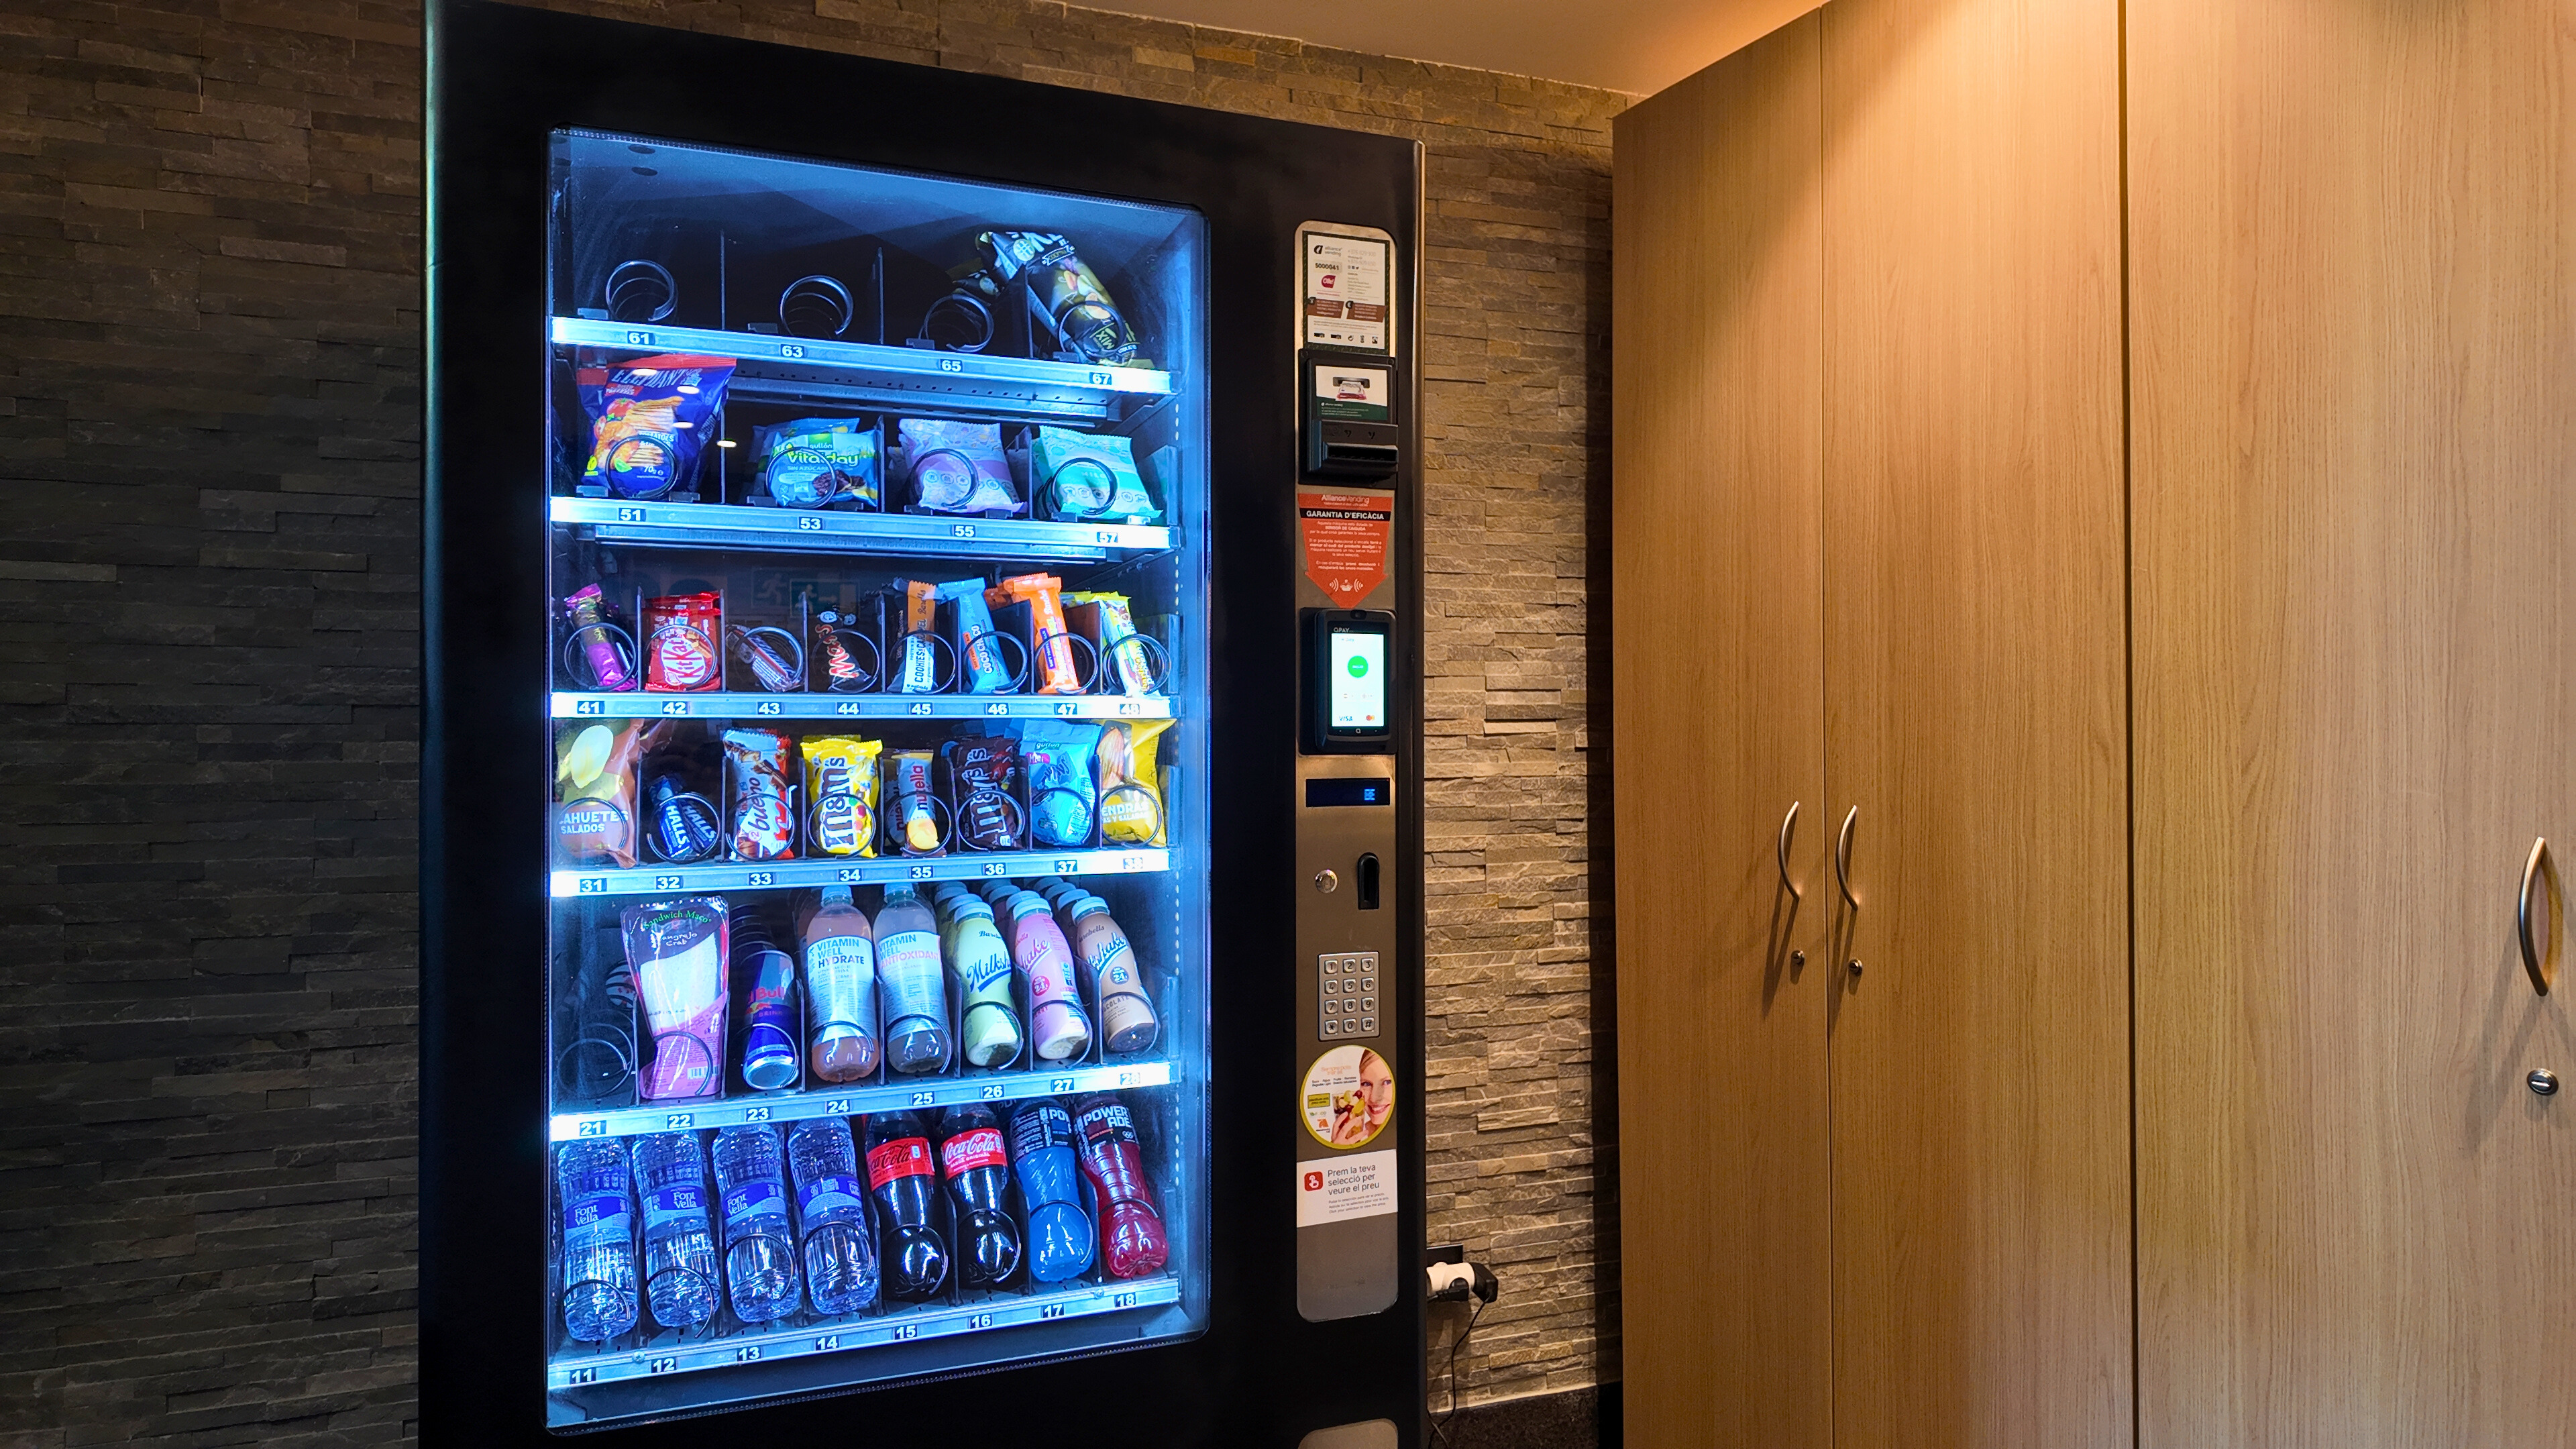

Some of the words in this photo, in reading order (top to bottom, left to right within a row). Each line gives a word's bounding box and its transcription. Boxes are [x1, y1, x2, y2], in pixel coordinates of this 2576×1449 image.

[629, 332, 649, 344] 61
[782, 345, 803, 358] 63
[941, 360, 962, 372] 65
[1092, 373, 1110, 384] 67
[620, 509, 641, 521] 51
[1344, 511, 1385, 520] D'EFICÀCIA
[800, 517, 821, 529] 53
[955, 526, 975, 537] 55
[1099, 532, 1118, 543] 57
[971, 624, 987, 652] CHCO
[816, 624, 860, 679] Mars
[662, 639, 703, 679] KitKat
[979, 651, 994, 674] COCO
[914, 653, 926, 683] COOKIES
[579, 702, 600, 714] 41
[663, 702, 686, 714] 42
[759, 702, 780, 714] 43
[838, 703, 859, 714] 44
[911, 703, 932, 715] 45
[987, 703, 1008, 715] 46
[1057, 704, 1076, 715] 47
[1121, 704, 1140, 715] 48
[912, 765, 928, 811] nuella
[739, 789, 749, 816] kinr
[747, 776, 771, 831] bueno
[1102, 801, 1149, 816] ENDRAS
[561, 823, 605, 835] SALADOS
[912, 867, 932, 878] 35
[985, 864, 1005, 875] 36
[1058, 861, 1076, 872] 37
[750, 873, 771, 885] 33
[840, 869, 861, 881] 34
[581, 879, 602, 892] 31
[657, 876, 680, 889] 32
[643, 910, 683, 930] Sandwich
[661, 931, 698, 941] angrejo
[665, 938, 688, 947] Crab
[817, 938, 859, 951] VITAMIN
[878, 934, 916, 952] VITAMIN
[818, 947, 843, 959] WELL
[879, 946, 901, 960] WELL
[881, 950, 939, 969] ANTIOXIDANT
[1021, 938, 1051, 970] hake
[818, 955, 865, 969] HYDRATE
[966, 951, 1012, 992] Milksh
[1053, 1079, 1073, 1091] 27
[1122, 1073, 1140, 1085] 28
[983, 1085, 1003, 1098] 26
[913, 1093, 934, 1106] 25
[828, 1100, 849, 1113] 24
[668, 1114, 690, 1128] 22
[747, 1108, 769, 1122] 23
[1083, 1106, 1128, 1126] POWER
[580, 1122, 602, 1135] 21
[1108, 1116, 1132, 1128] ADE
[945, 1132, 996, 1165] Coca-Cola
[1328, 1169, 1348, 1177] Prem
[1359, 1165, 1376, 1173] teva
[1328, 1175, 1360, 1186] selecció
[1362, 1174, 1376, 1183] per
[1328, 1186, 1351, 1195] veure
[1352, 1184, 1360, 1192] el
[1362, 1181, 1380, 1192] preu
[673, 1191, 696, 1201] Font
[727, 1193, 747, 1209] Font
[673, 1197, 697, 1209] Vella
[728, 1201, 749, 1216] Vella
[575, 1204, 598, 1218] Font
[575, 1213, 600, 1226] Vella
[1118, 1293, 1135, 1306] 18
[1044, 1304, 1063, 1317] 17
[972, 1314, 991, 1328] 16
[896, 1326, 916, 1339] 15
[817, 1336, 839, 1350] 14
[739, 1346, 760, 1360] 13
[653, 1359, 676, 1373] 12
[572, 1370, 593, 1383] 11
